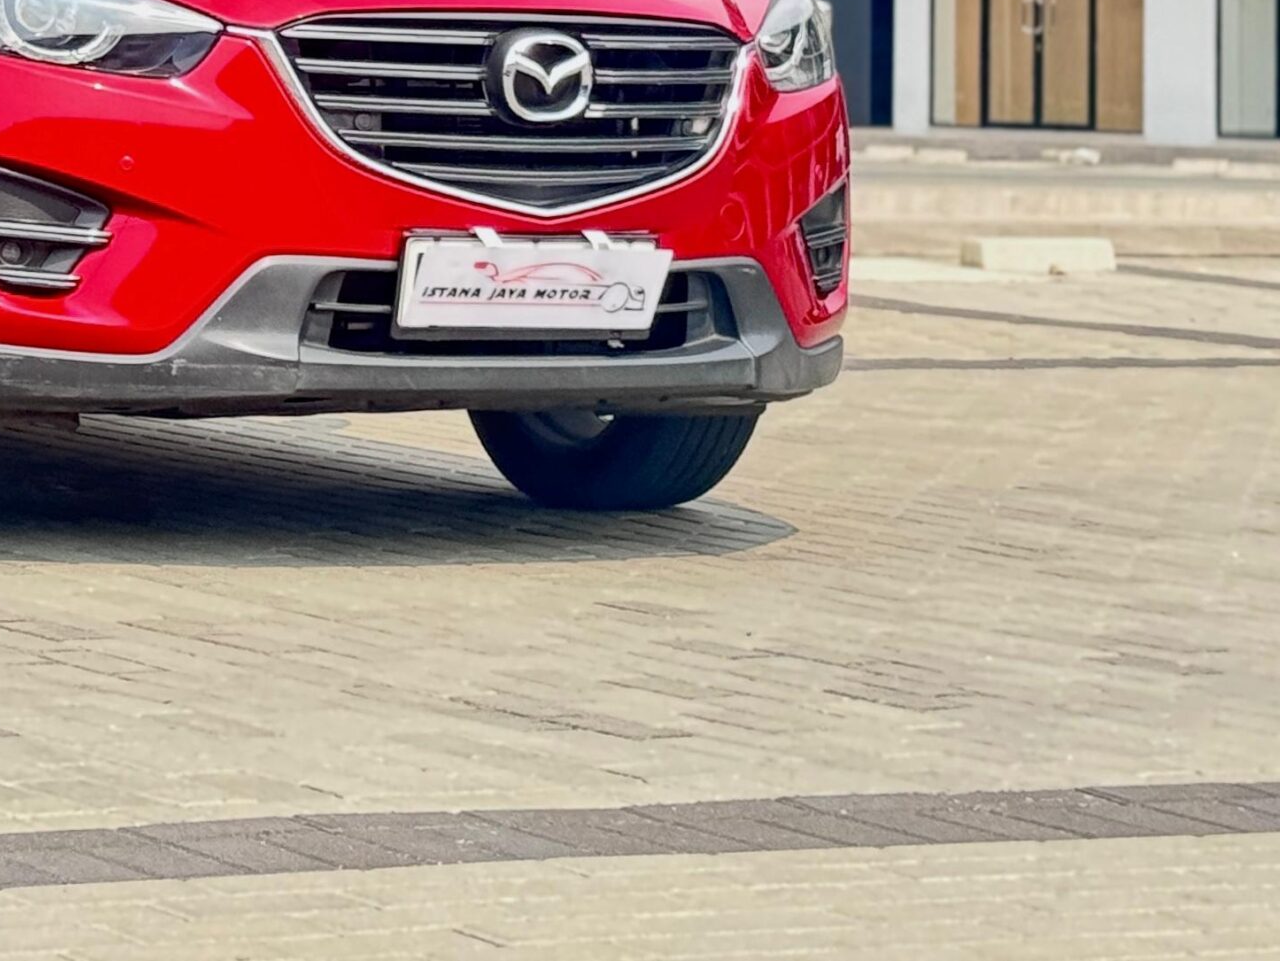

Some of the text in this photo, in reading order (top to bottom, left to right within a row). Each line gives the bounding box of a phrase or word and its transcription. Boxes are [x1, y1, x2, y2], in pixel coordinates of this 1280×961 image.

[421, 286, 591, 300] ISTANA JAYA MOTOR
